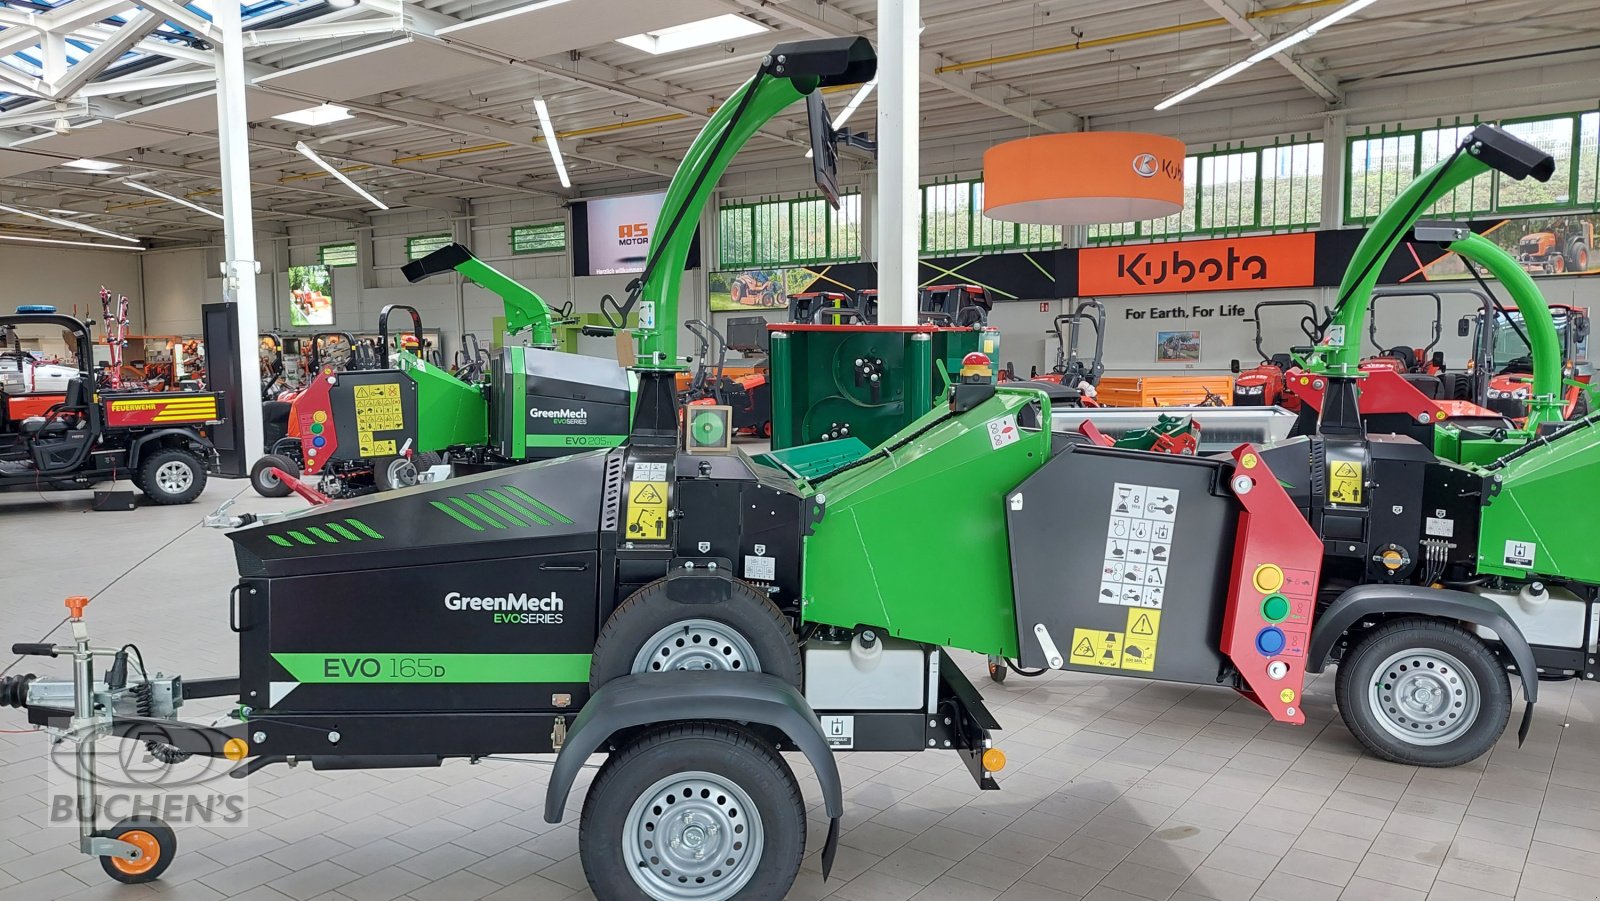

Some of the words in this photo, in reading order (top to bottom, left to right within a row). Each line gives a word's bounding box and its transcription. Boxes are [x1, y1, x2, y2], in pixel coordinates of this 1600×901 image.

[619, 237, 648, 245] MOTOR
[1118, 247, 1267, 285] Kubota
[1126, 308, 1146, 319] For
[1150, 306, 1189, 319] Earth,
[1193, 306, 1214, 317] For
[1220, 305, 1245, 317] Life
[111, 403, 156, 412] FEUERWEHR
[529, 408, 587, 418] GreenMech
[565, 437, 587, 445] EVO
[1133, 495, 1139, 503] 8
[444, 591, 564, 611] GreenMech
[493, 613, 563, 624] EVOSERIES
[324, 658, 381, 678] EVO
[389, 658, 446, 678] 165D
